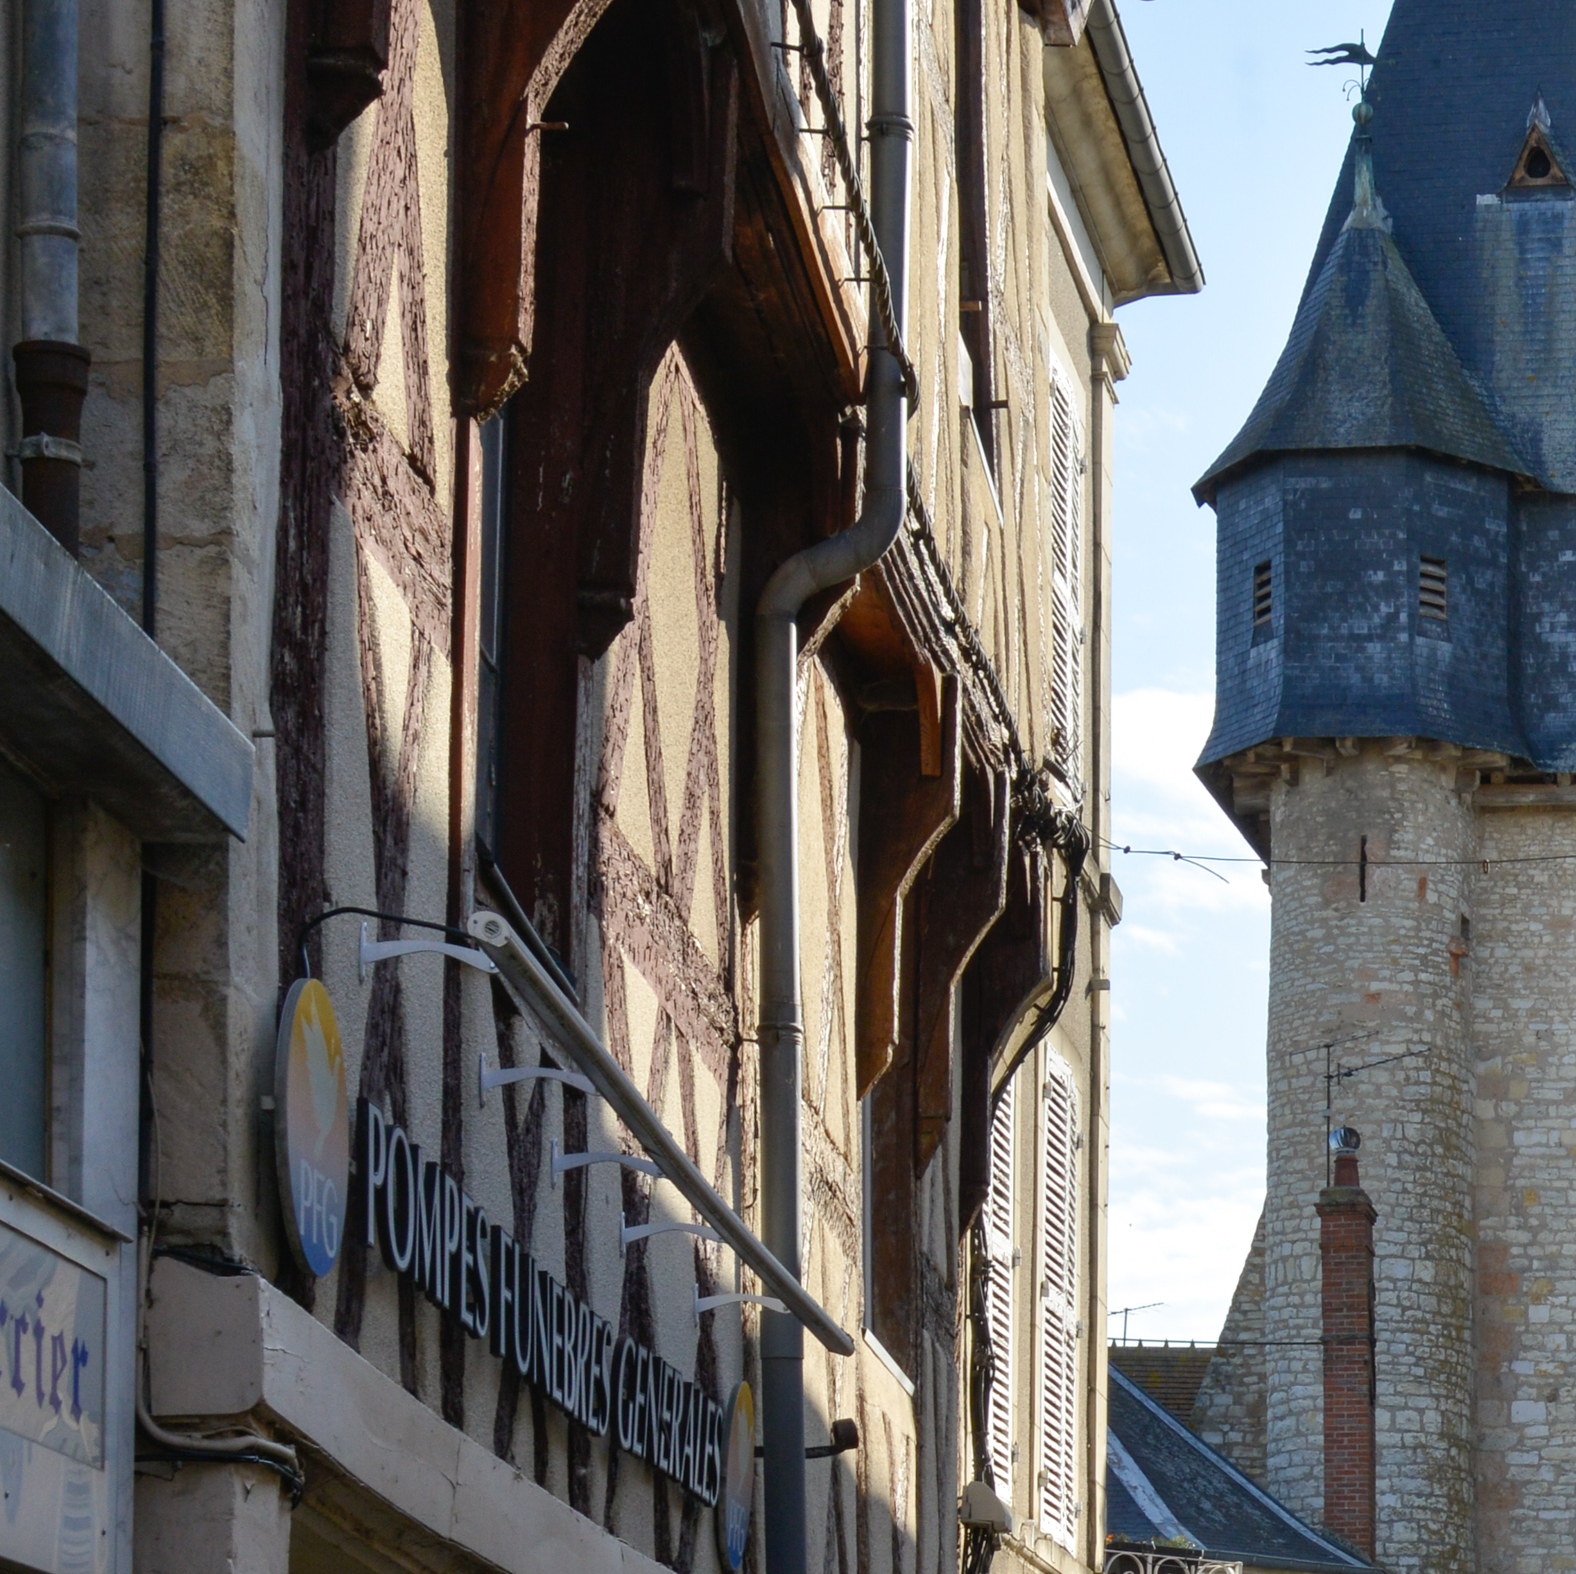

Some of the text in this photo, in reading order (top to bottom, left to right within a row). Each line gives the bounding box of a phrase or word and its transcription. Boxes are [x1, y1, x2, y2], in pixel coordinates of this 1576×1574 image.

[300, 1158, 338, 1259] PFG
[0, 1289, 89, 1425] rier
[367, 1101, 724, 1508] POMPES FUNEBRES GENERALES
